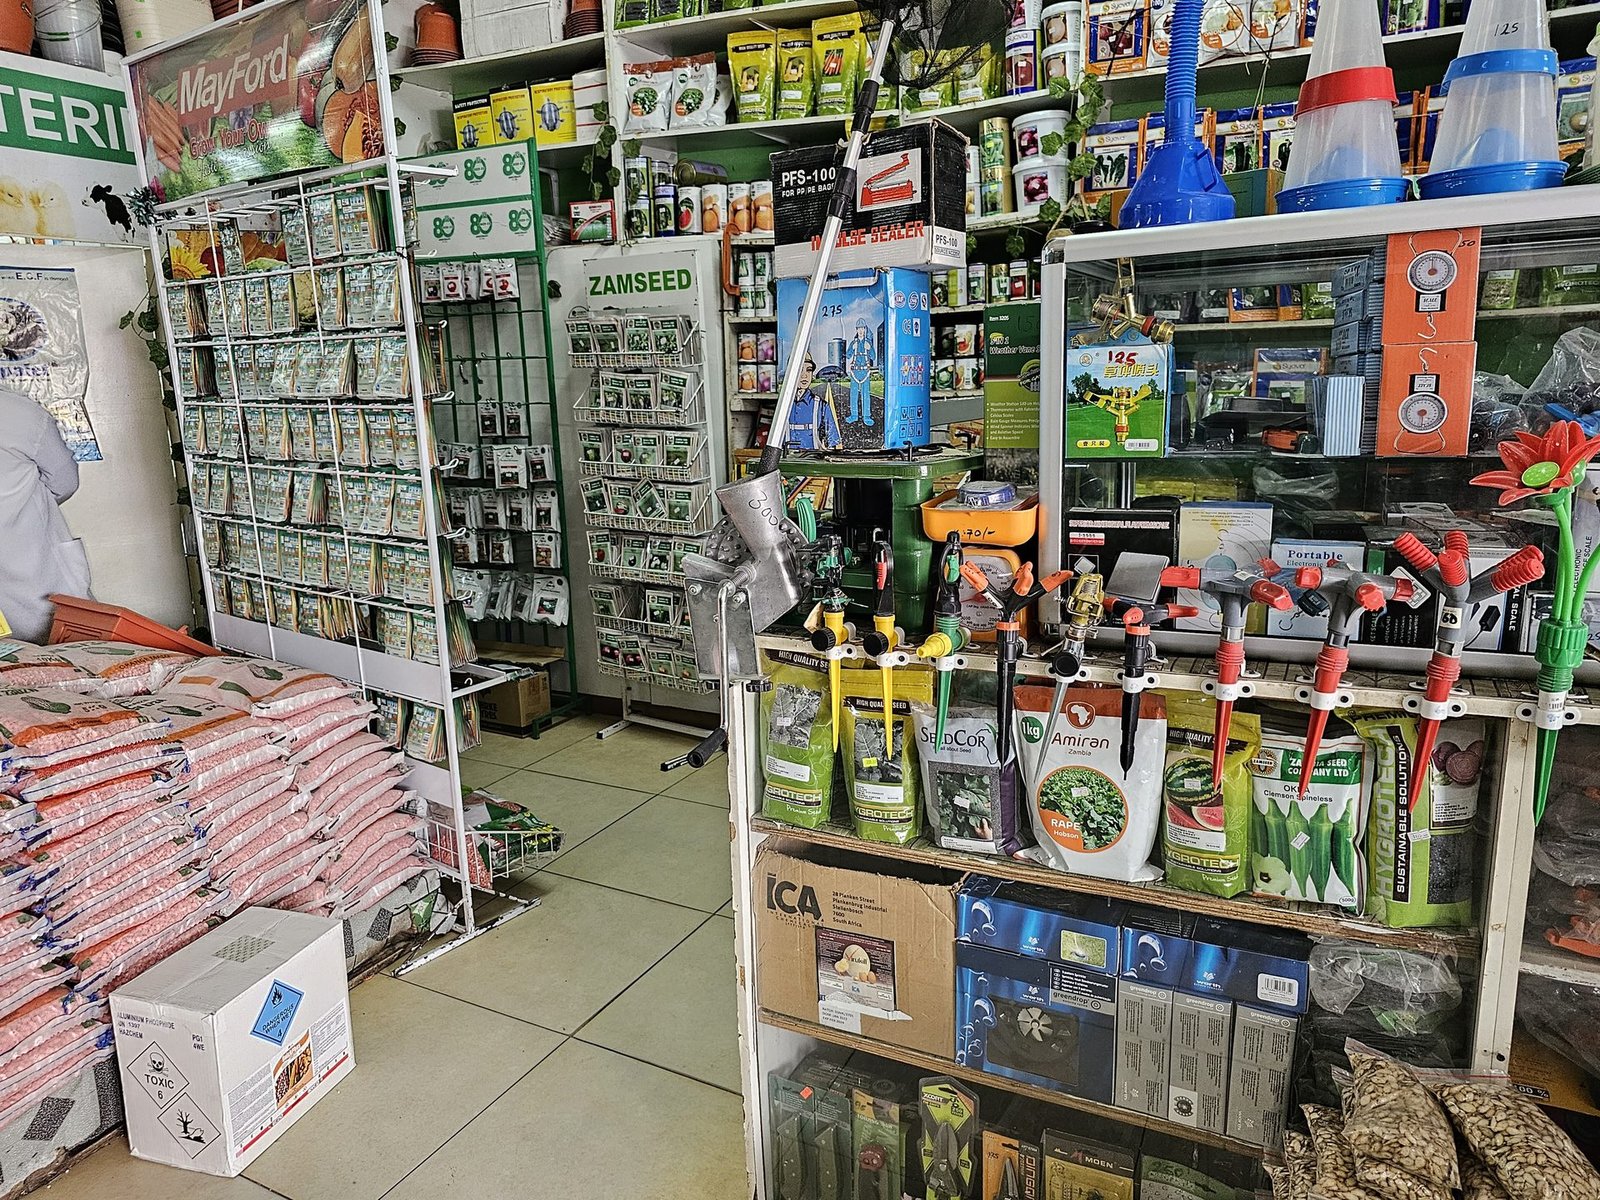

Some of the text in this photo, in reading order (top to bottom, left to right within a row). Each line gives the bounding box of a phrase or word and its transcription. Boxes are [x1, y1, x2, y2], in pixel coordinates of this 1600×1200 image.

[1494, 22, 1519, 36] 125
[180, 34, 289, 115] MayFord
[0, 85, 134, 152] TERI
[189, 137, 216, 160] Grow
[219, 127, 246, 149] Your
[464, 151, 526, 181] 80 80
[781, 166, 836, 188] PFS-100
[782, 189, 795, 198] FOR
[433, 207, 532, 239] 80 80 80
[871, 220, 925, 244] SEALER
[935, 233, 958, 249] PFS-100
[1458, 239, 1476, 248] 50
[588, 268, 692, 296] ZAMSEED
[821, 304, 843, 318] 275
[989, 345, 1035, 355] Weather Vane
[1108, 350, 1138, 367] 125
[748, 491, 779, 526] 3000
[1583, 535, 1593, 558] SCALE
[1287, 549, 1344, 560] Portable
[1286, 560, 1324, 568] Electronic
[1508, 603, 1519, 631] SCALE
[778, 650, 829, 670] HIGH QUALITY SE
[856, 699, 907, 709] HIGH QUAL SEED
[920, 726, 985, 748] SEDCOR
[1022, 721, 1041, 739] 1kg
[1169, 729, 1212, 744] HIGH QUALITY
[1052, 731, 1110, 750] Amiran
[1067, 748, 1092, 757] Zambia
[1327, 758, 1347, 767] SEED
[1287, 767, 1349, 777] COANY LTD
[766, 785, 823, 802] GROTECH
[1263, 789, 1295, 800] Clemson
[1283, 784, 1310, 794] OKA
[855, 805, 914, 819] YGROTECH
[1376, 727, 1395, 899] HYGROTECH
[1392, 734, 1408, 894] SUSTAINABLE SOLUTIONS
[1051, 818, 1081, 831] RAPE
[1053, 830, 1079, 840] Hobson
[1166, 848, 1240, 870] YGROTECH
[767, 872, 822, 921] ICA
[838, 892, 859, 901] Planken
[859, 896, 875, 904] Street
[832, 898, 888, 913] Plankenbrug Industrial
[832, 904, 864, 915] Stellenbosch
[832, 910, 845, 918] 7600
[832, 917, 847, 926] South
[847, 920, 863, 928] Africa
[1129, 984, 1157, 996] greendrop
[1053, 991, 1089, 1005] greendrop
[1185, 996, 1215, 1009] greendrop
[117, 1011, 176, 1029] ALUMINIUM PHOSPHIDE
[262, 1003, 295, 1032] DANGEROUS
[265, 1010, 293, 1034] WHEN WET
[1250, 1010, 1280, 1024] greendrop
[119, 1029, 144, 1039] HAZCHEM
[192, 1034, 203, 1043] PG1
[277, 1028, 283, 1038] 4
[144, 1073, 175, 1090] TOXIC
[157, 1089, 164, 1100] 6
[1085, 1157, 1114, 1169] MOEN
